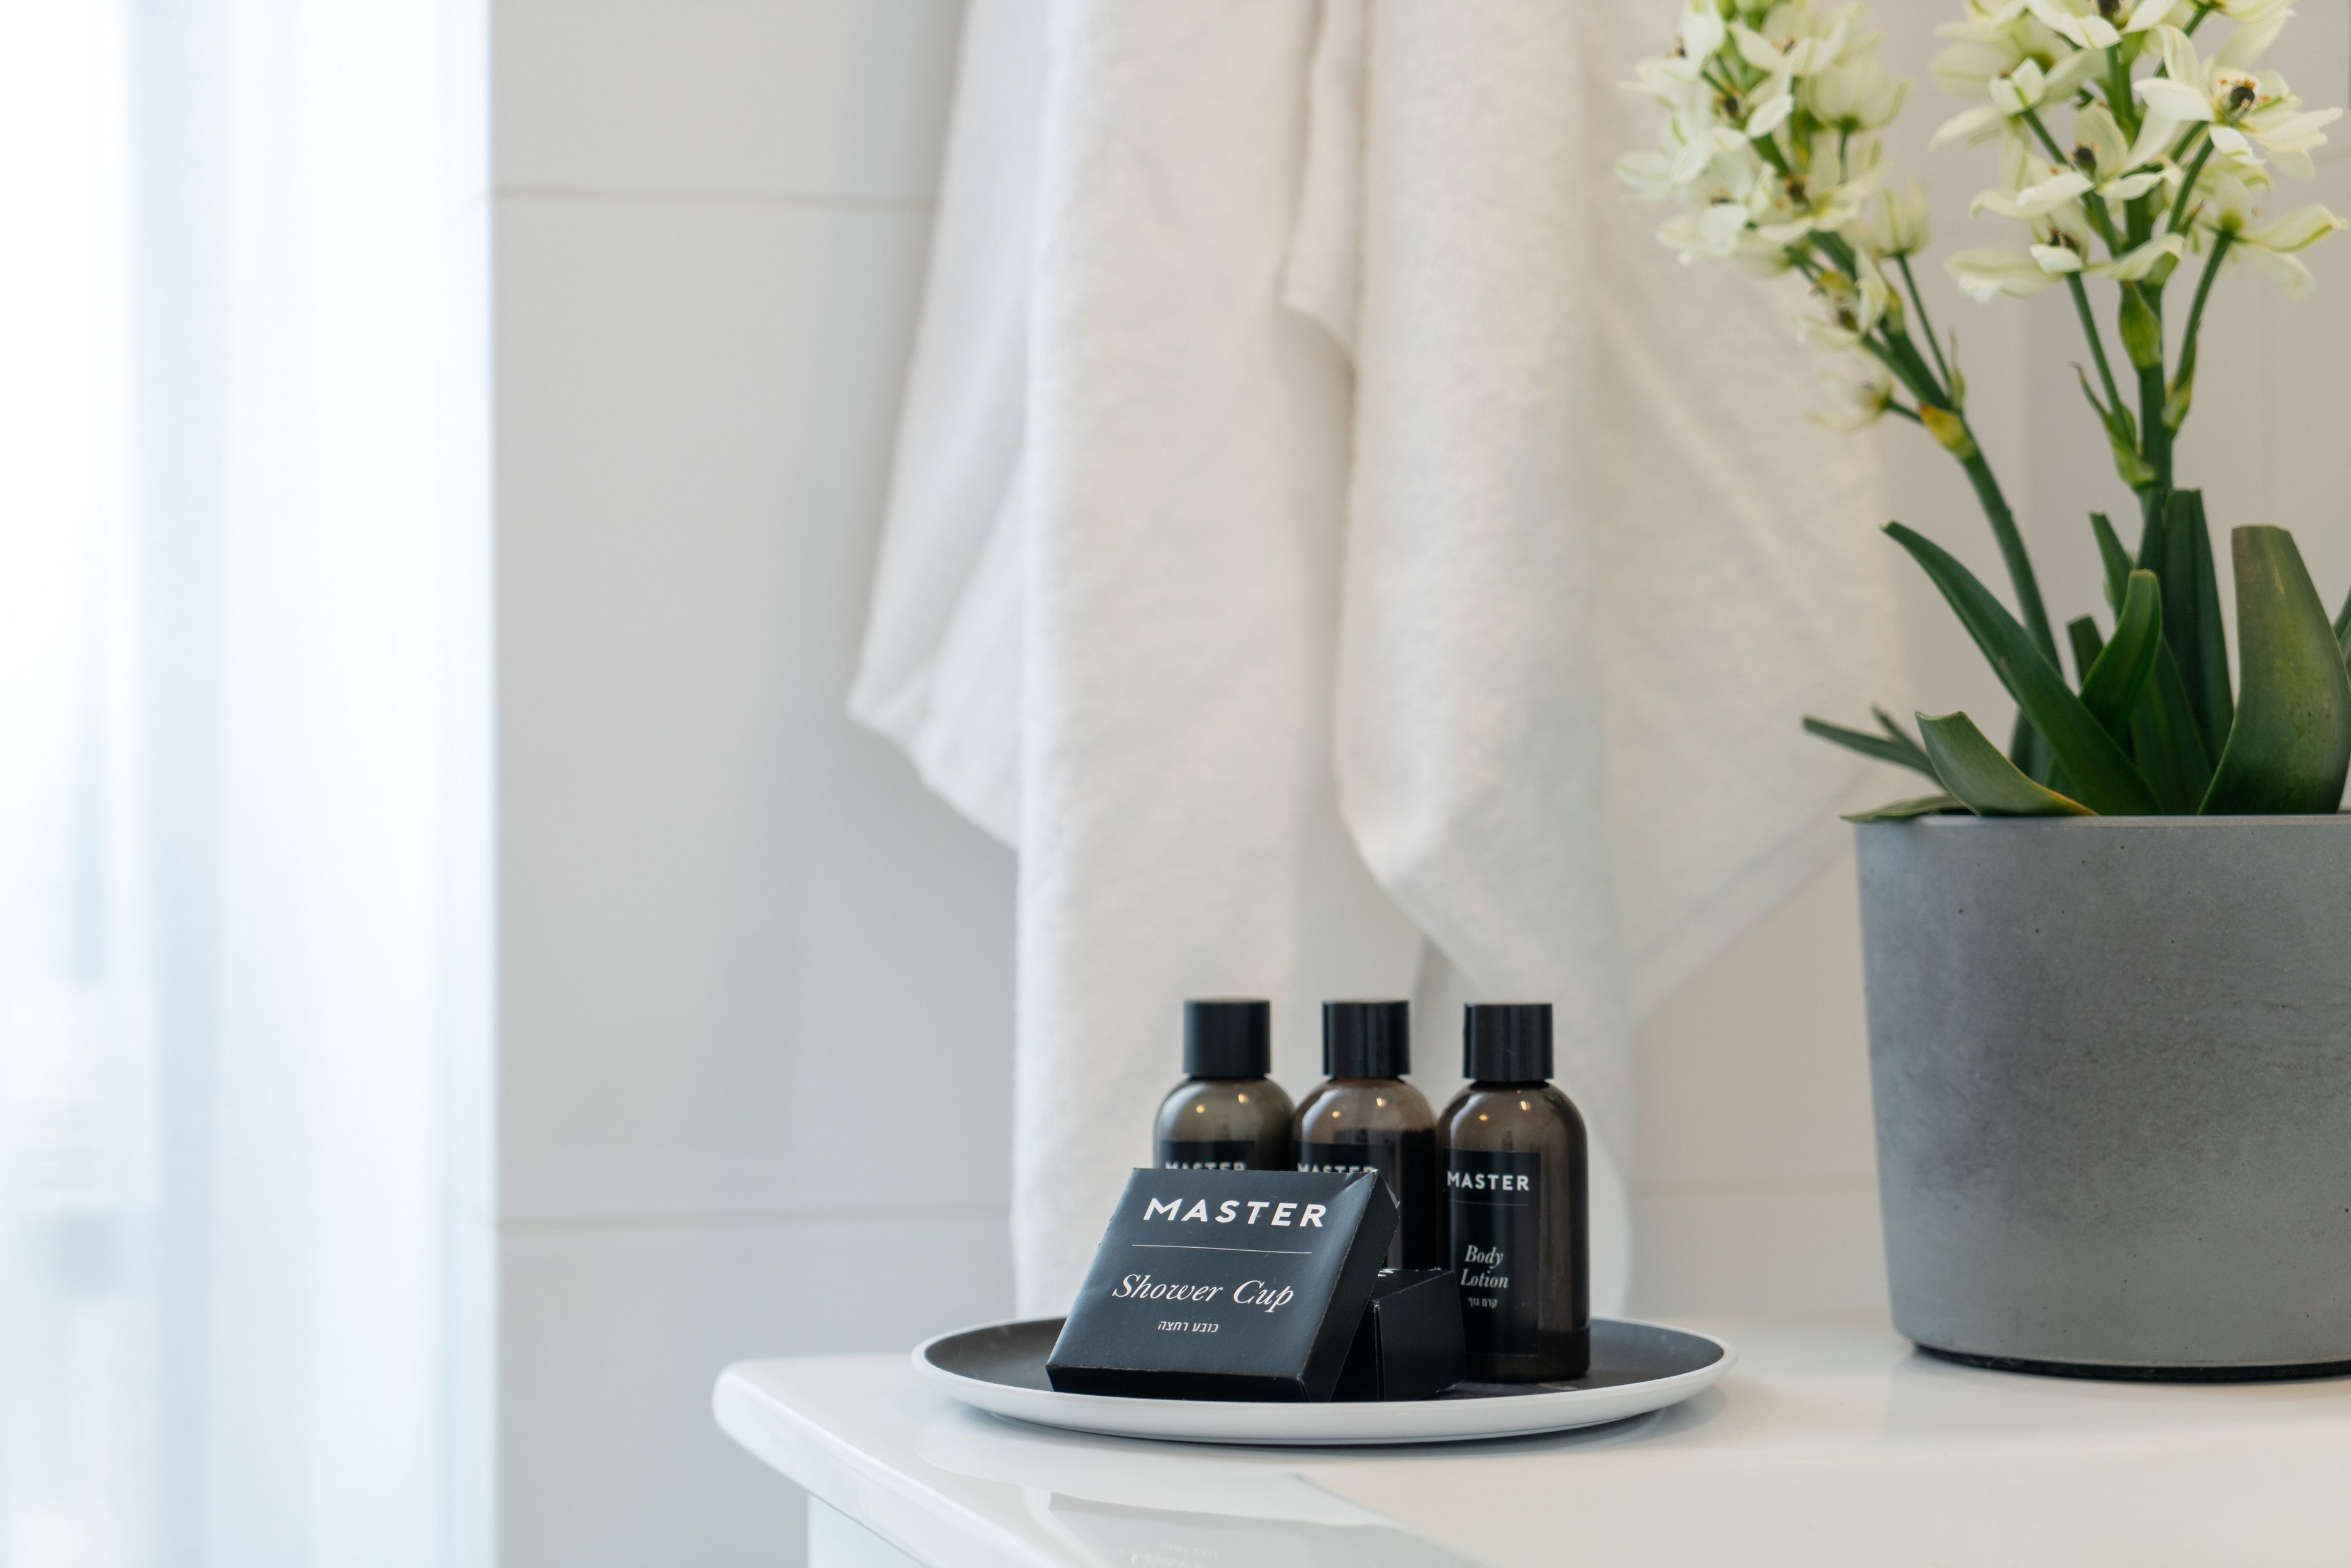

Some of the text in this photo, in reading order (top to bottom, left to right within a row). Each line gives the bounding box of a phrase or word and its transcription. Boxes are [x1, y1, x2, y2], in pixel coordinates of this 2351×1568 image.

[1447, 1171, 1530, 1191] MASTER
[1142, 1198, 1327, 1228] MASTER
[1464, 1244, 1504, 1270] Body
[1460, 1268, 1509, 1289] Lotion
[1111, 1274, 1294, 1313] Shower Cup
[1157, 1321, 1219, 1333] כובע רחצה
